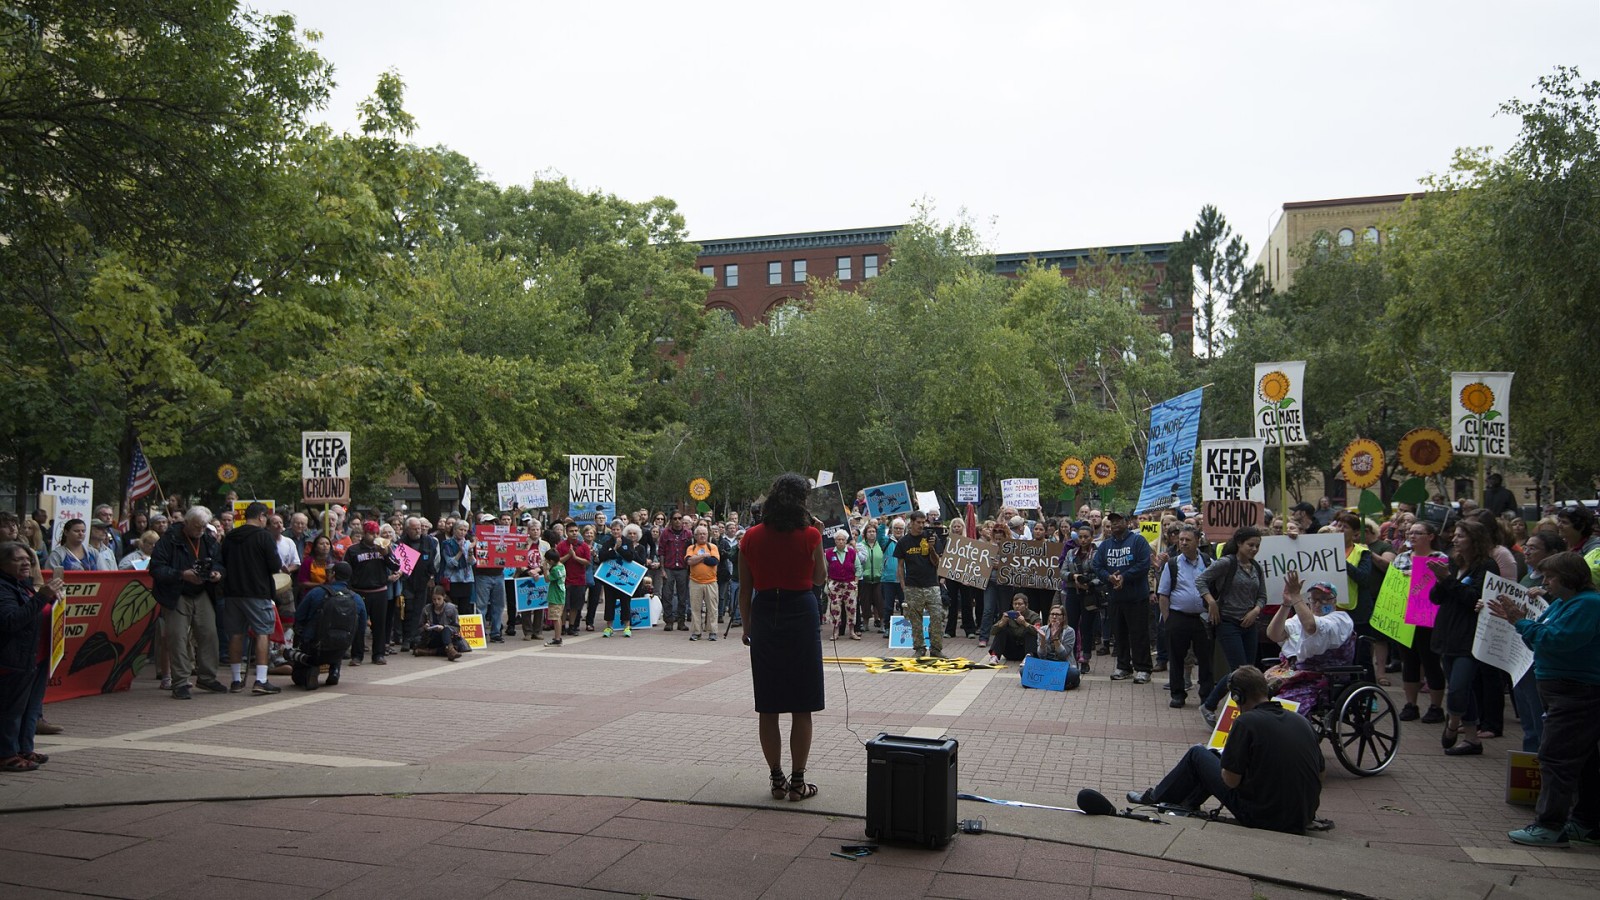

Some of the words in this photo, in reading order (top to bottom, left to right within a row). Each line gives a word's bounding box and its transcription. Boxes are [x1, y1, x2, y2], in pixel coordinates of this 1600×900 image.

[1150, 426, 1161, 440] NO
[1162, 415, 1185, 436] MORE
[1465, 420, 1505, 437] CLIMATE
[306, 438, 344, 458] KEEP
[1154, 441, 1167, 457] OIL
[1455, 435, 1505, 454] JUSTICE
[309, 459, 319, 467] IT
[322, 459, 332, 467] IN
[572, 457, 616, 471] HONOR
[1206, 448, 1257, 475] KEEP
[311, 468, 332, 477] THE
[580, 473, 605, 487] THE
[306, 478, 345, 498] GROUND
[1210, 474, 1224, 486] IT
[1228, 475, 1242, 487] IN
[570, 488, 613, 503] WATER
[1214, 487, 1241, 500] THE
[1207, 500, 1258, 528] GROUND
[1020, 541, 1047, 557] Paul
[1107, 547, 1131, 558] LIVING
[82, 585, 96, 595] IT
[1485, 577, 1526, 601] ANYBODY
[74, 604, 100, 616] THE
[1028, 672, 1044, 682] NOT
